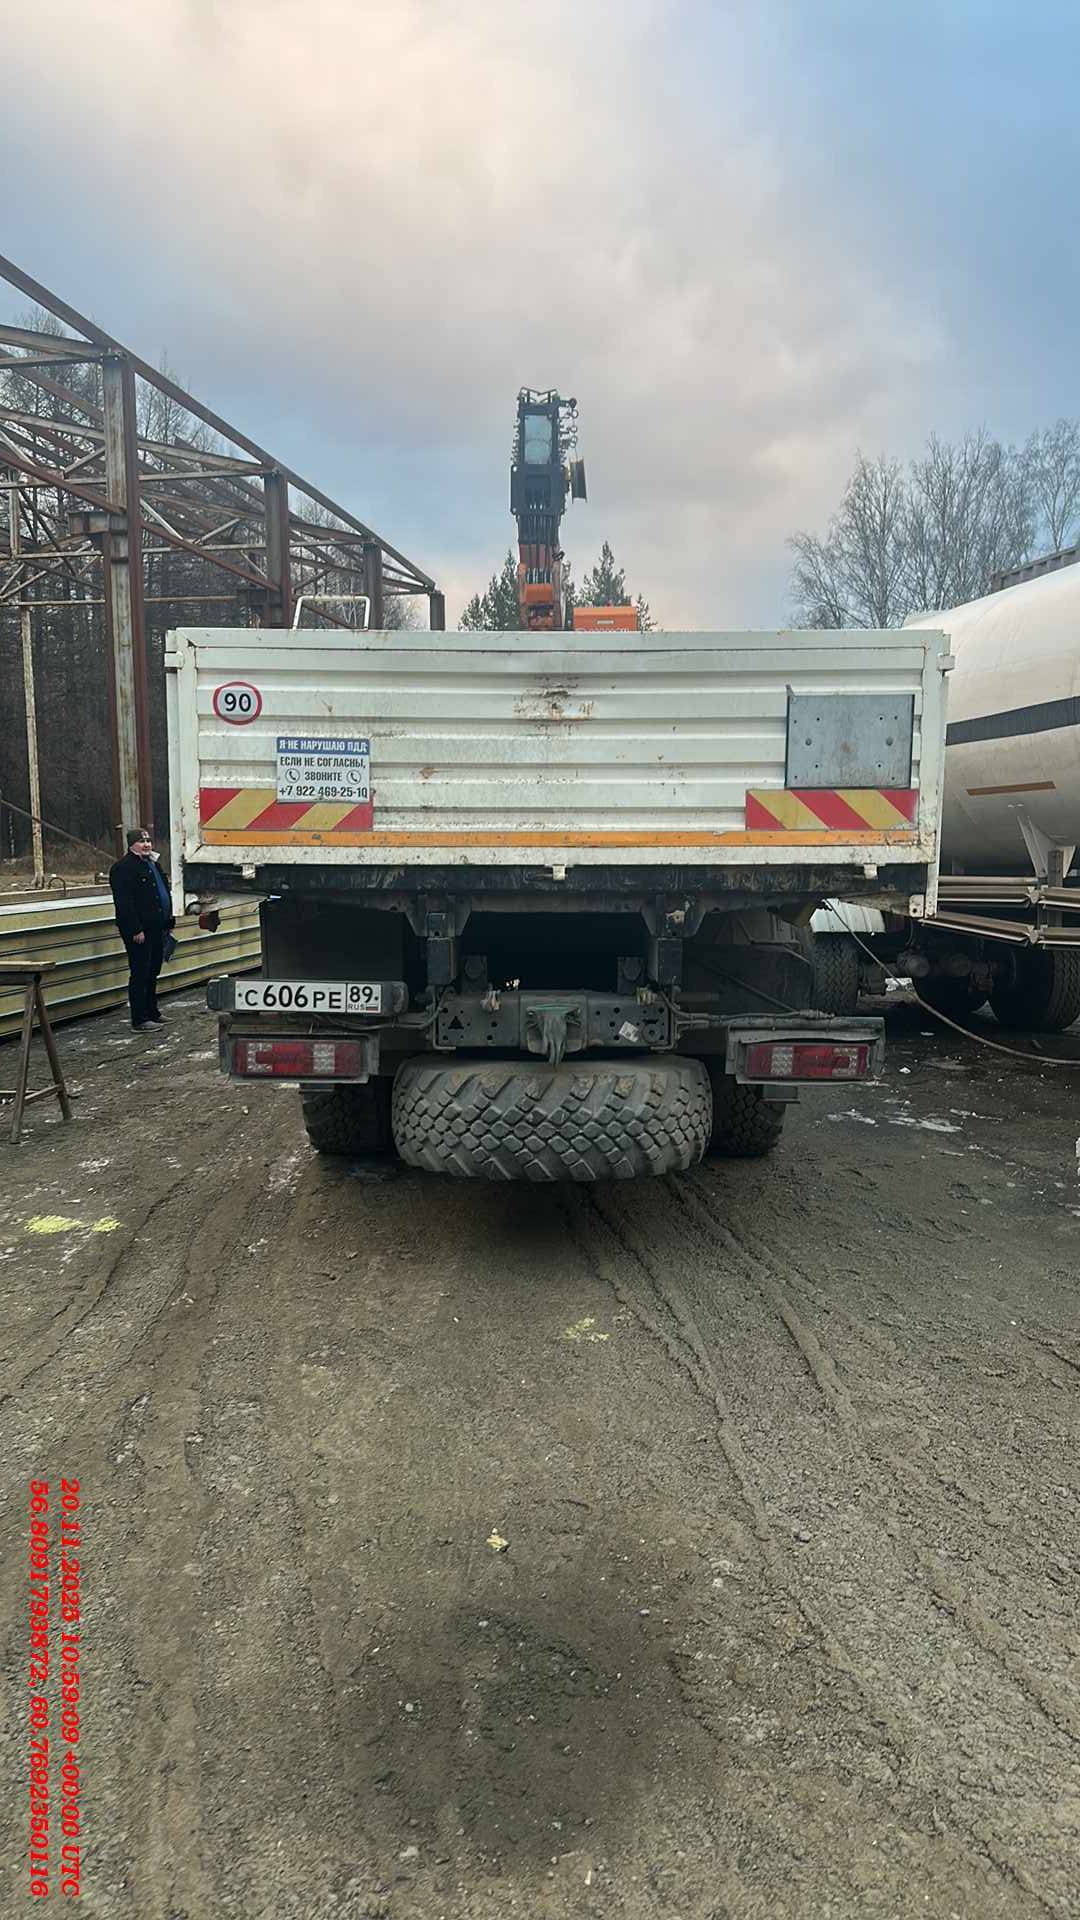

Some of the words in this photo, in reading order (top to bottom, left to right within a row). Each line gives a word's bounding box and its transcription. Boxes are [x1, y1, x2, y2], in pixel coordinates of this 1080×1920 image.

[224, 692, 252, 712] 90
[279, 739, 286, 750] Я
[288, 739, 299, 750] НЕ
[300, 739, 345, 751] НАРУШАЮ
[280, 756, 302, 767] ЕСЛИ
[304, 756, 315, 767] НЕ
[317, 757, 366, 769] СОГЛАСНЫ,
[304, 771, 342, 782] ЗВОНИТЕ
[279, 785, 293, 796] +7
[296, 785, 315, 797] 922
[318, 786, 368, 799] 469-25-10
[349, 985, 373, 1003] 89
